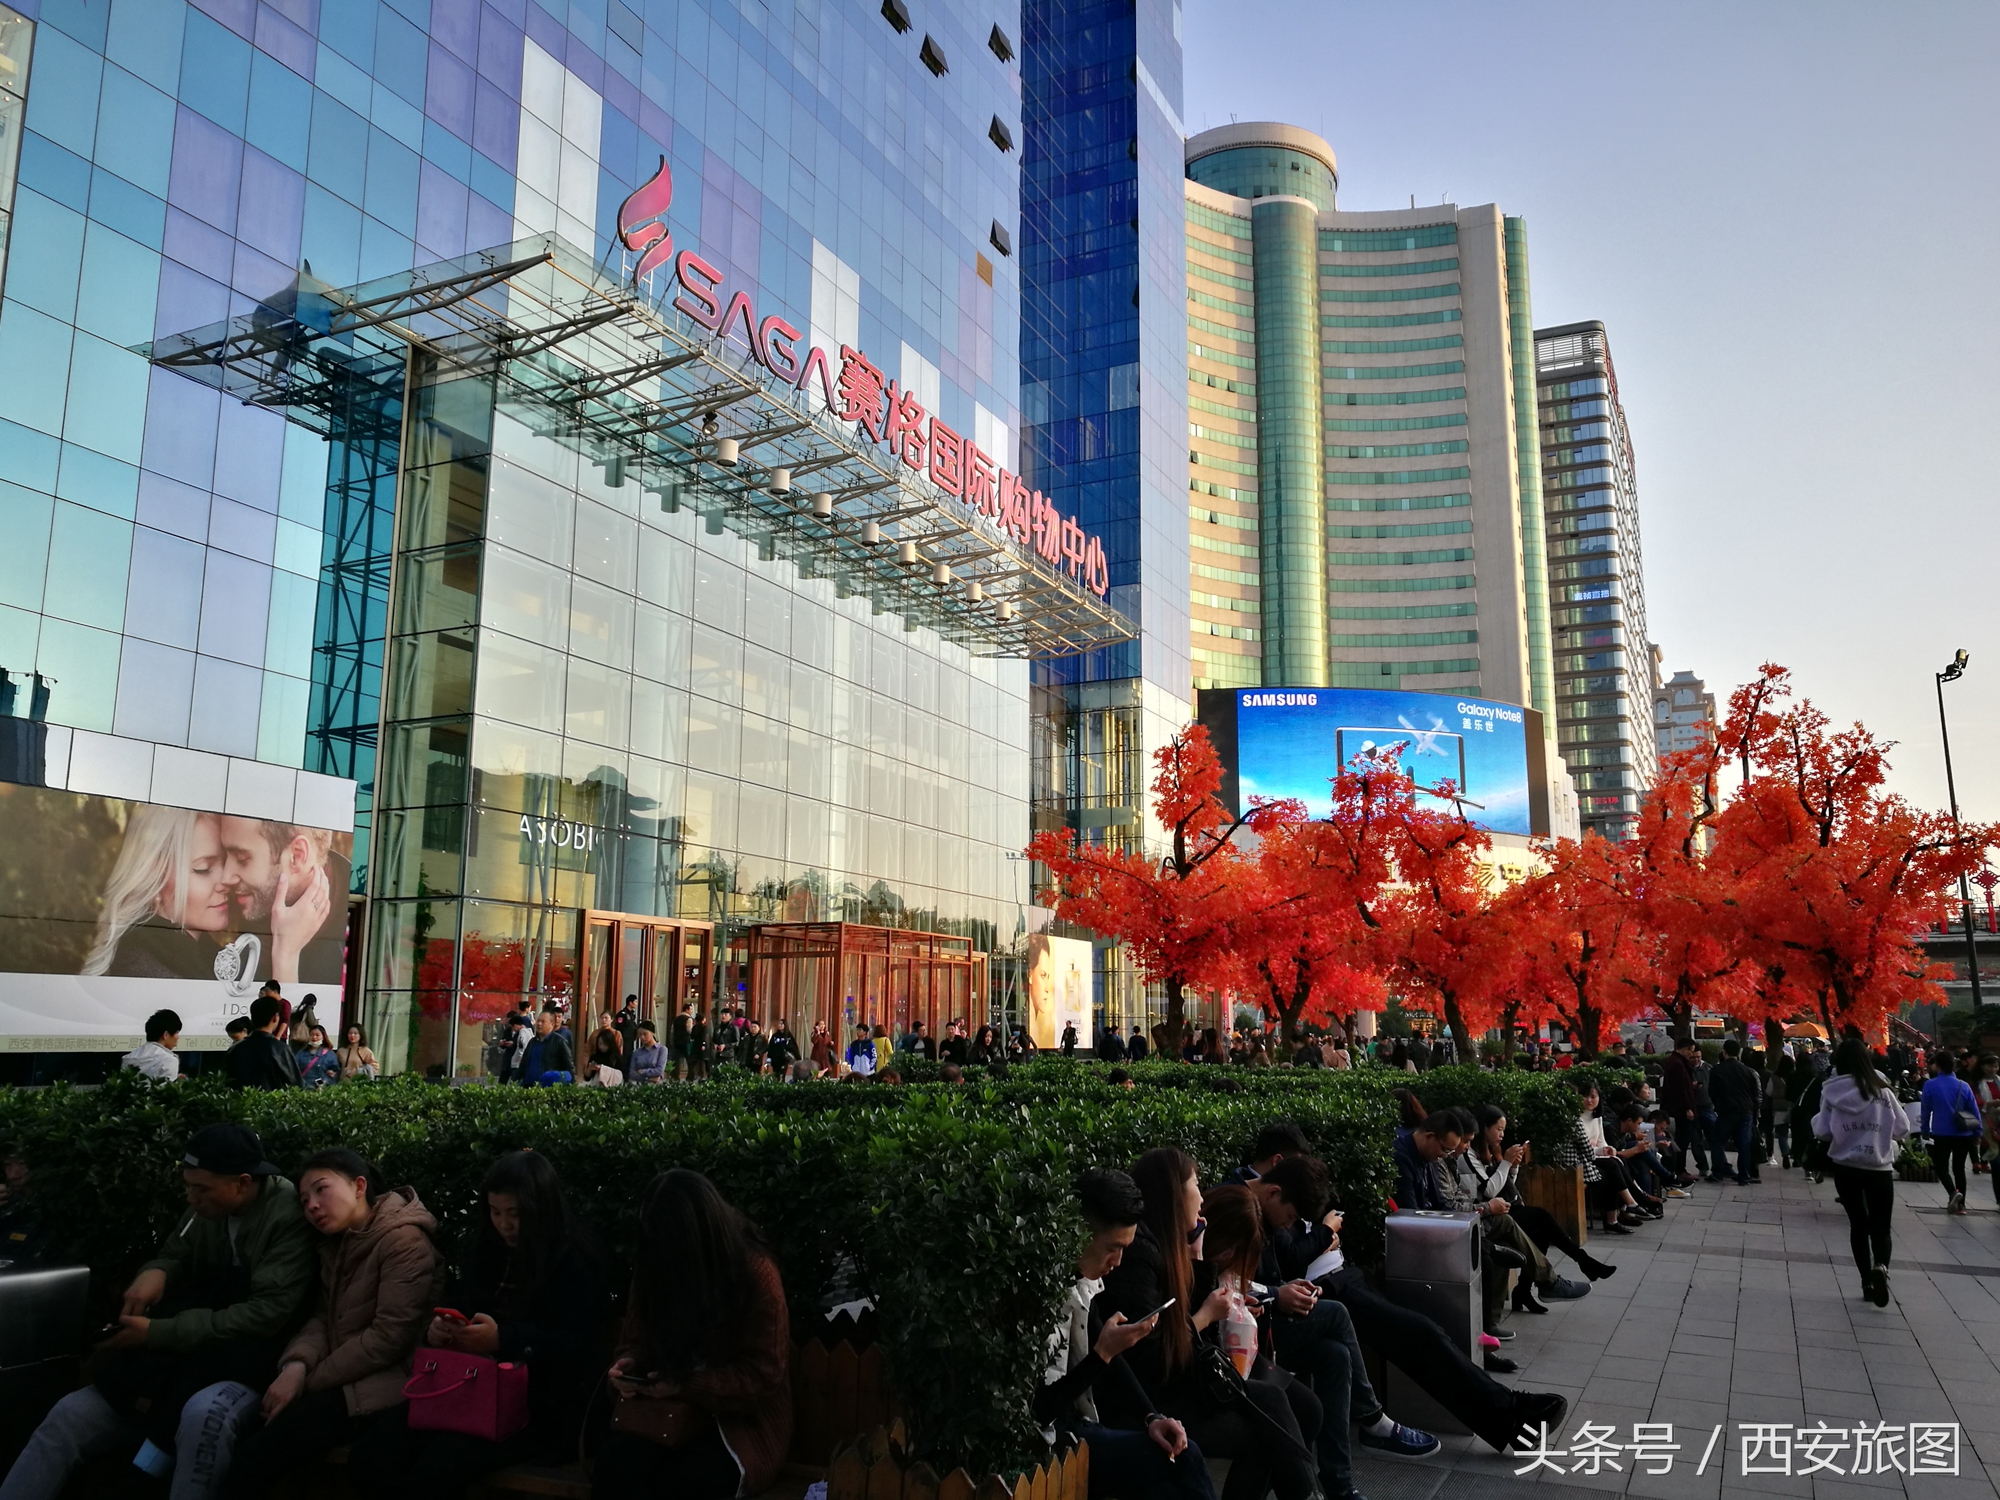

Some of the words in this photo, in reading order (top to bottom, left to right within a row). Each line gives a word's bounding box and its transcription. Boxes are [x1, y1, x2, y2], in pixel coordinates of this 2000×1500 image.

[672, 249, 838, 416] SAGA
[838, 343, 1109, 596] 赛格国际购物中心
[1242, 693, 1318, 708] SAMSUNG
[1457, 702, 1495, 720] Galaxy
[1495, 707, 1522, 724] Note8
[1462, 717, 1494, 733] 盖乐世
[520, 814, 599, 851] ASOBI
[222, 1003, 227, 1015] I
[230, 1003, 249, 1016] Do
[191, 1399, 230, 1490] MOMENT
